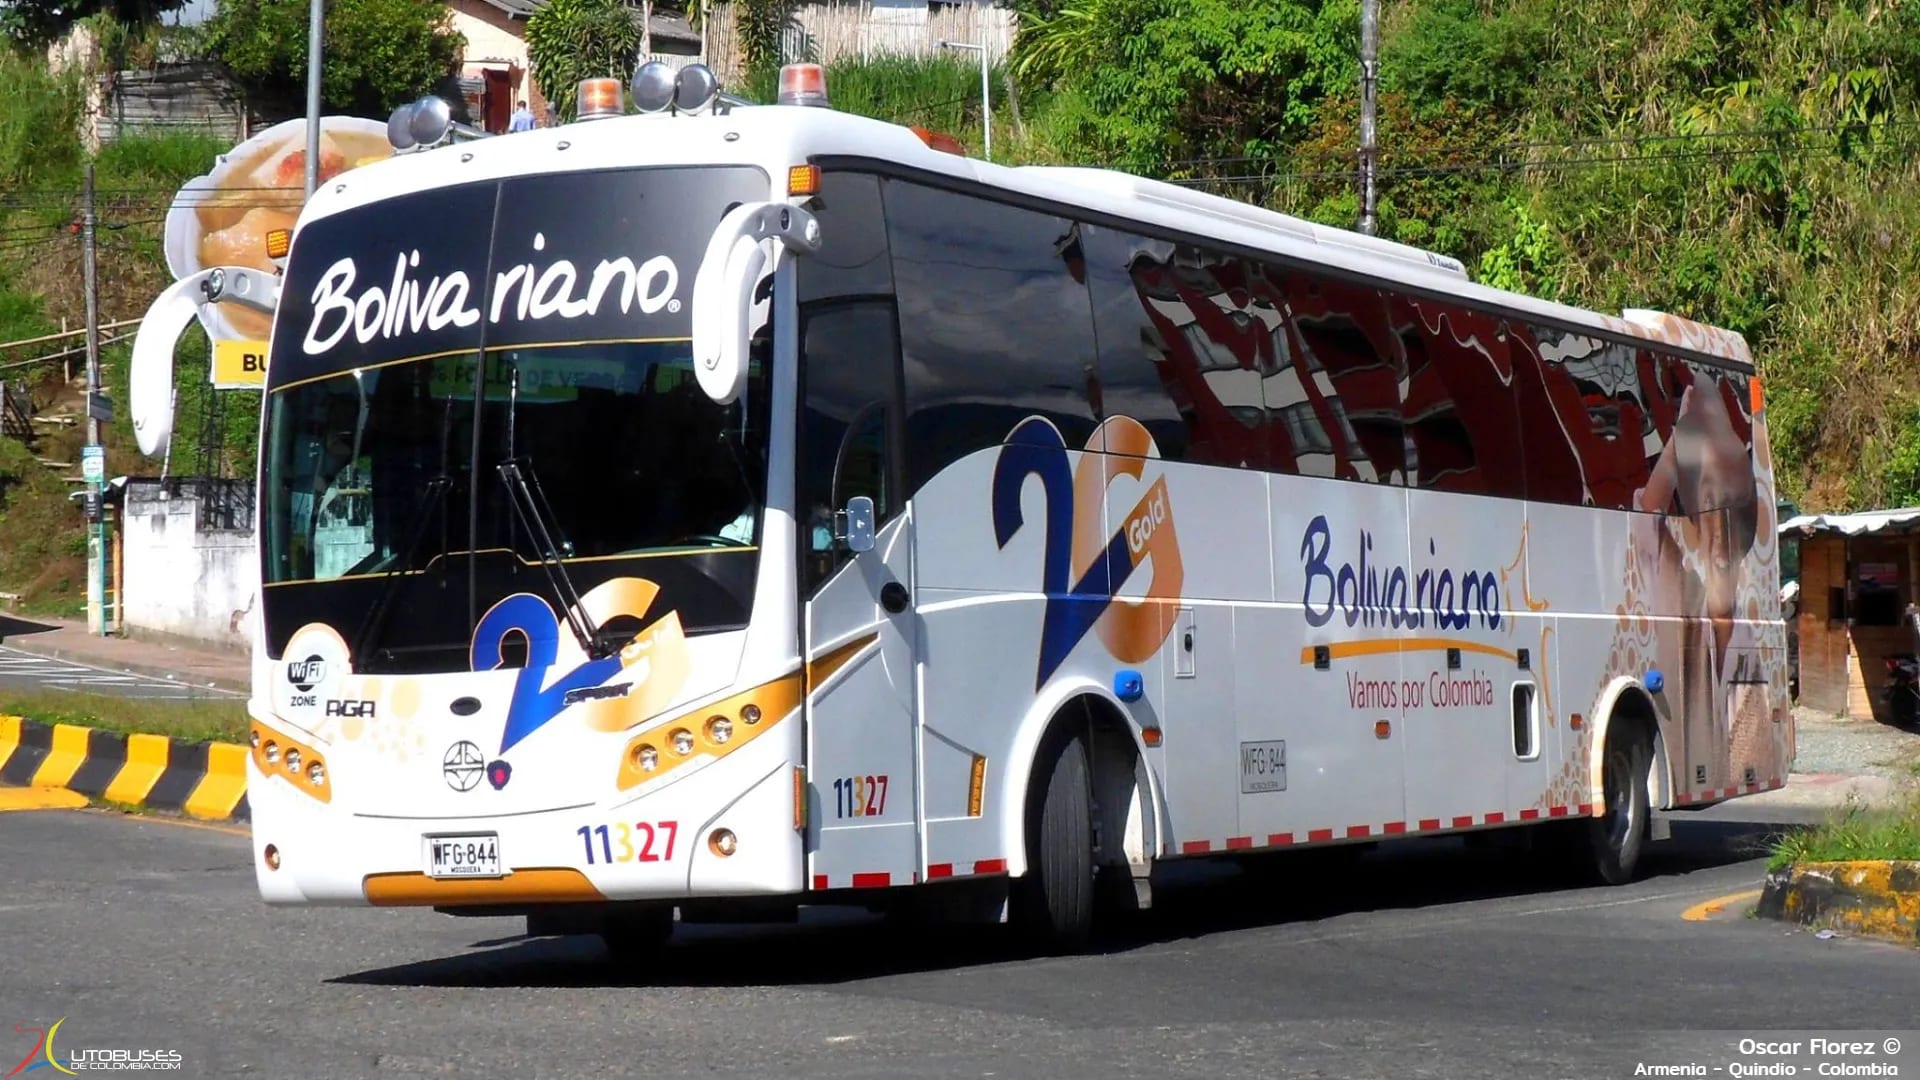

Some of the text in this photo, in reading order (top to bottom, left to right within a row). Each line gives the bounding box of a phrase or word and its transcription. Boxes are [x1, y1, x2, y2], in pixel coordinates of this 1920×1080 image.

[1129, 488, 1165, 553] Gold
[290, 695, 317, 707] ZONE
[326, 699, 376, 717] AGA
[1346, 669, 1494, 717] Vamos por Colombia
[833, 775, 889, 819] 11327
[576, 820, 679, 865] 11327
